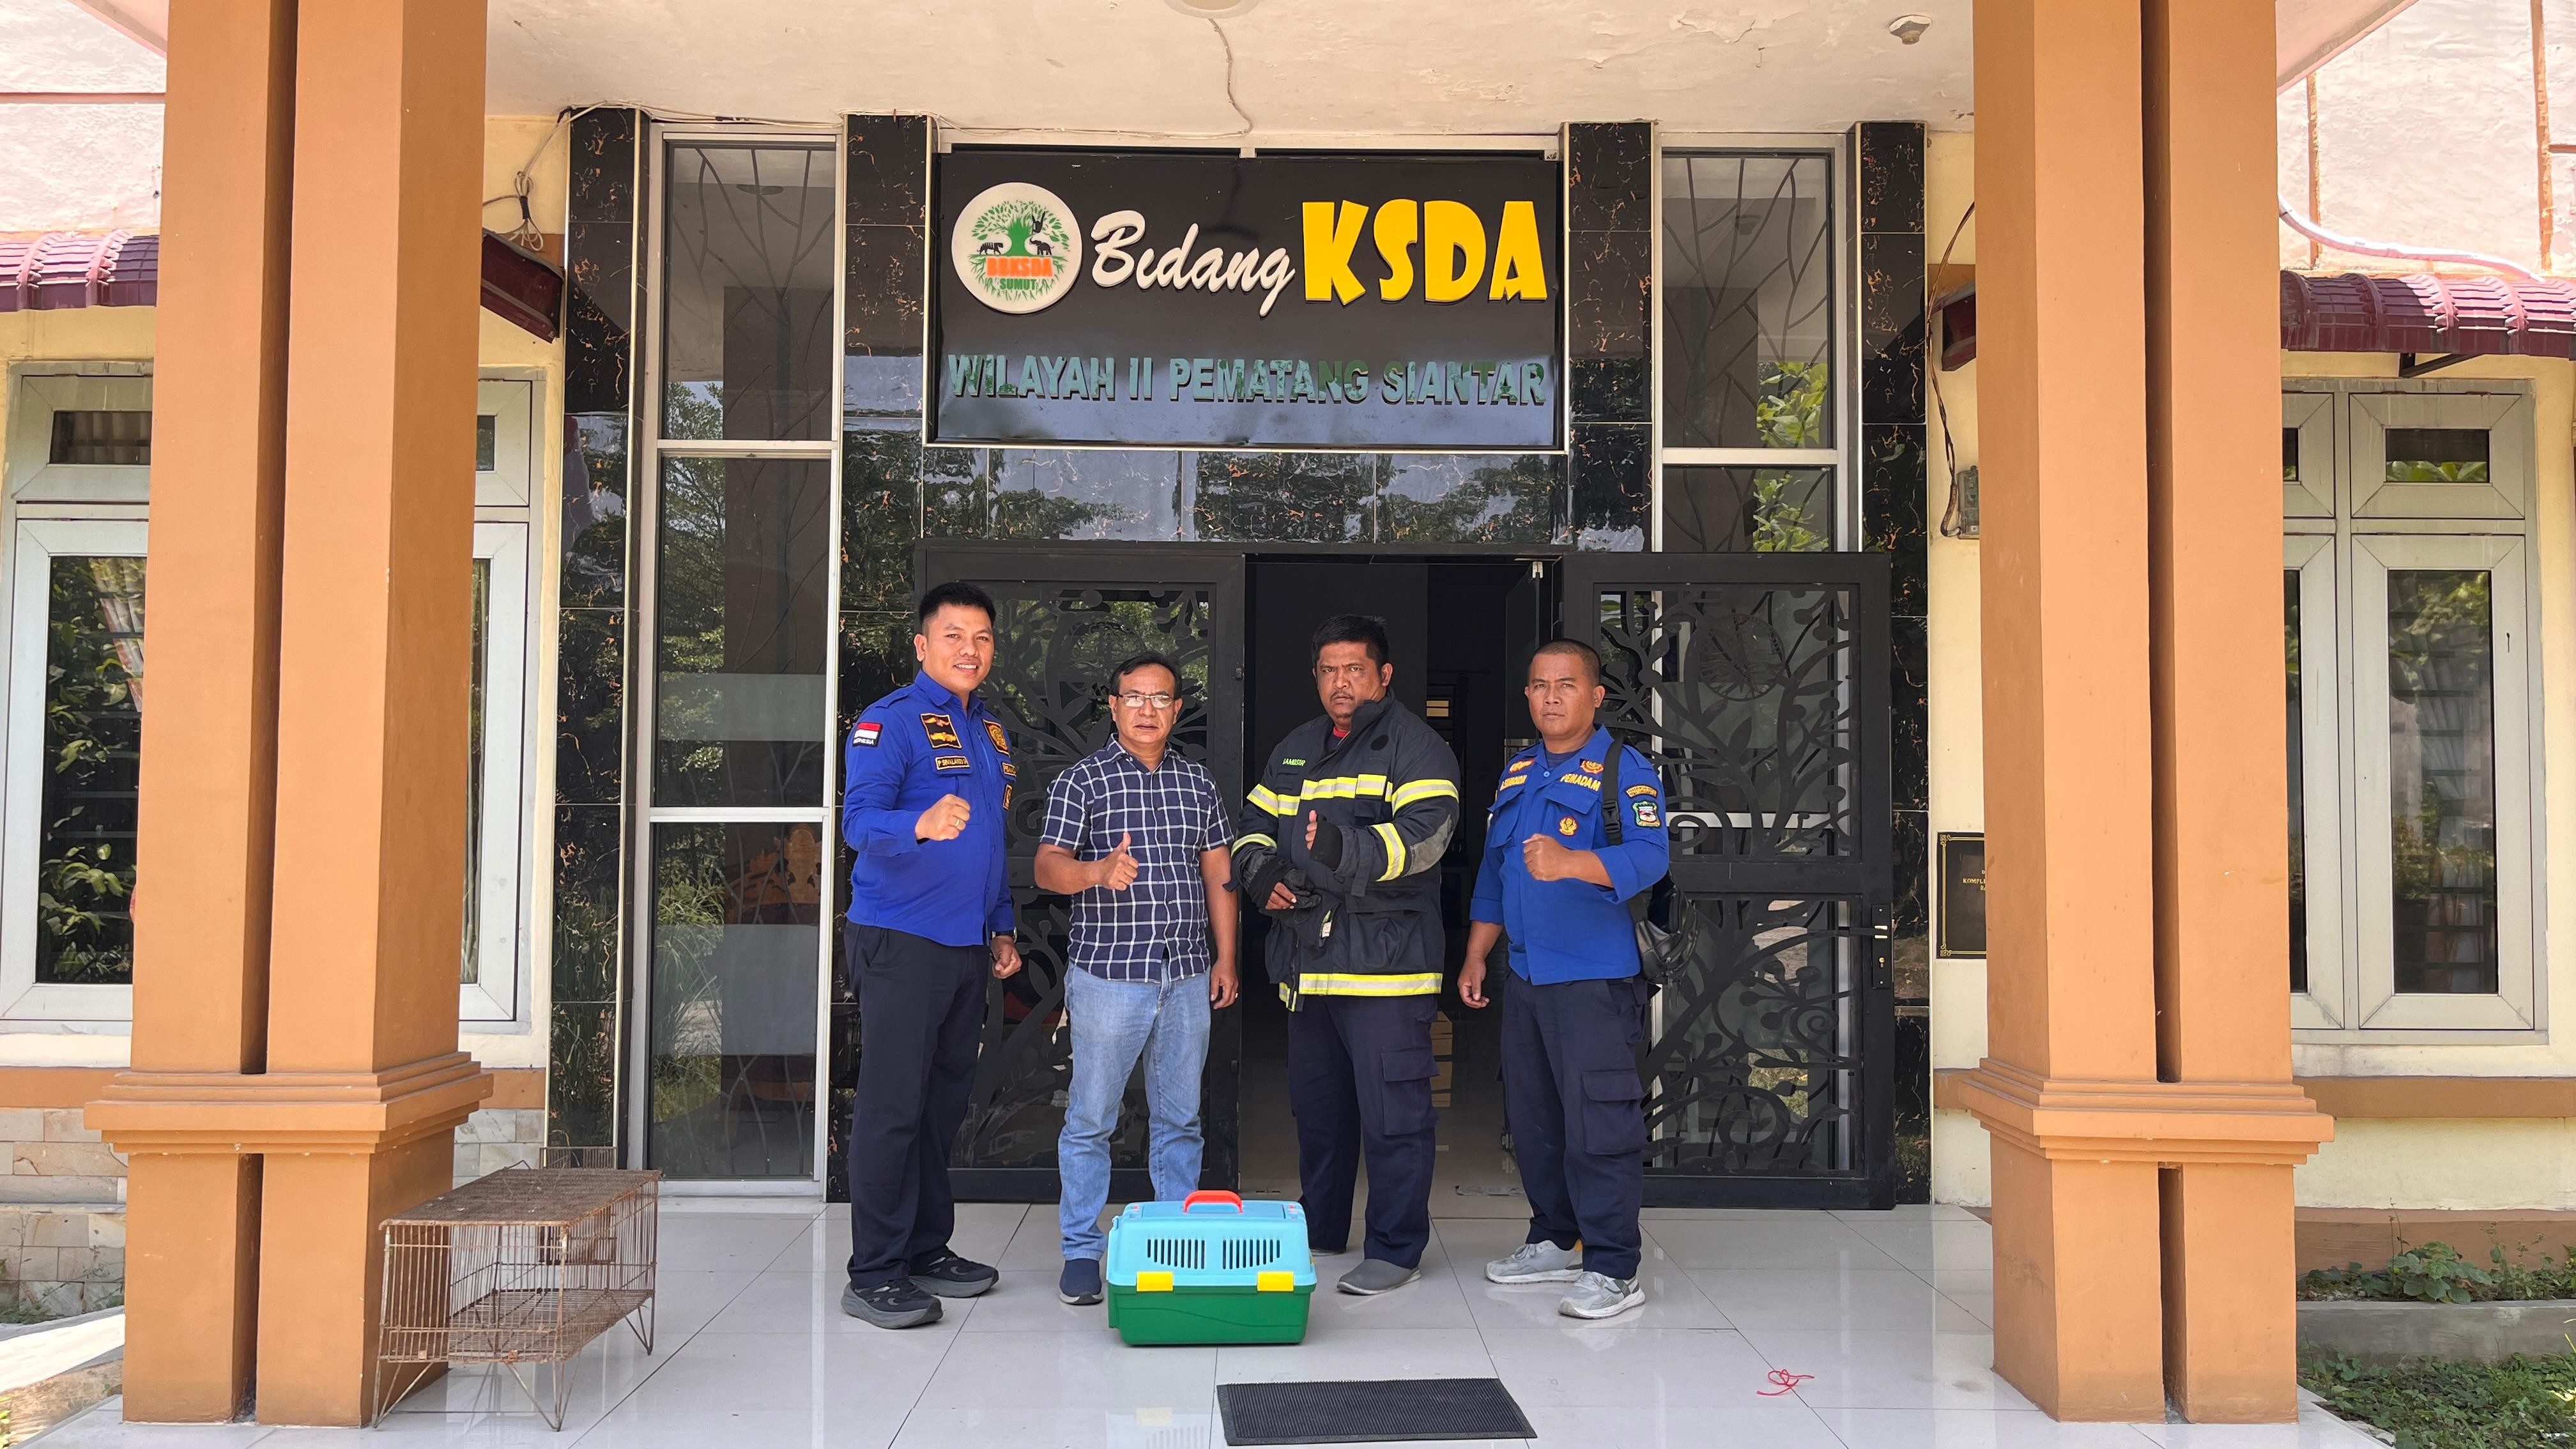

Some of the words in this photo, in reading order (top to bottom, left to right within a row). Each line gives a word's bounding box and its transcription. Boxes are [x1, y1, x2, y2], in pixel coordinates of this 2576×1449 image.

[1091, 210, 1296, 317] Bidang
[1302, 199, 1548, 305] KSDA
[999, 277, 1036, 291] SUMUT
[947, 354, 1115, 401] WILAYAH
[1130, 357, 1153, 402] II
[1170, 358, 1368, 404] PEMATANG
[1381, 360, 1547, 406] SIANTAR
[1560, 773, 1601, 792] PEMADAM
